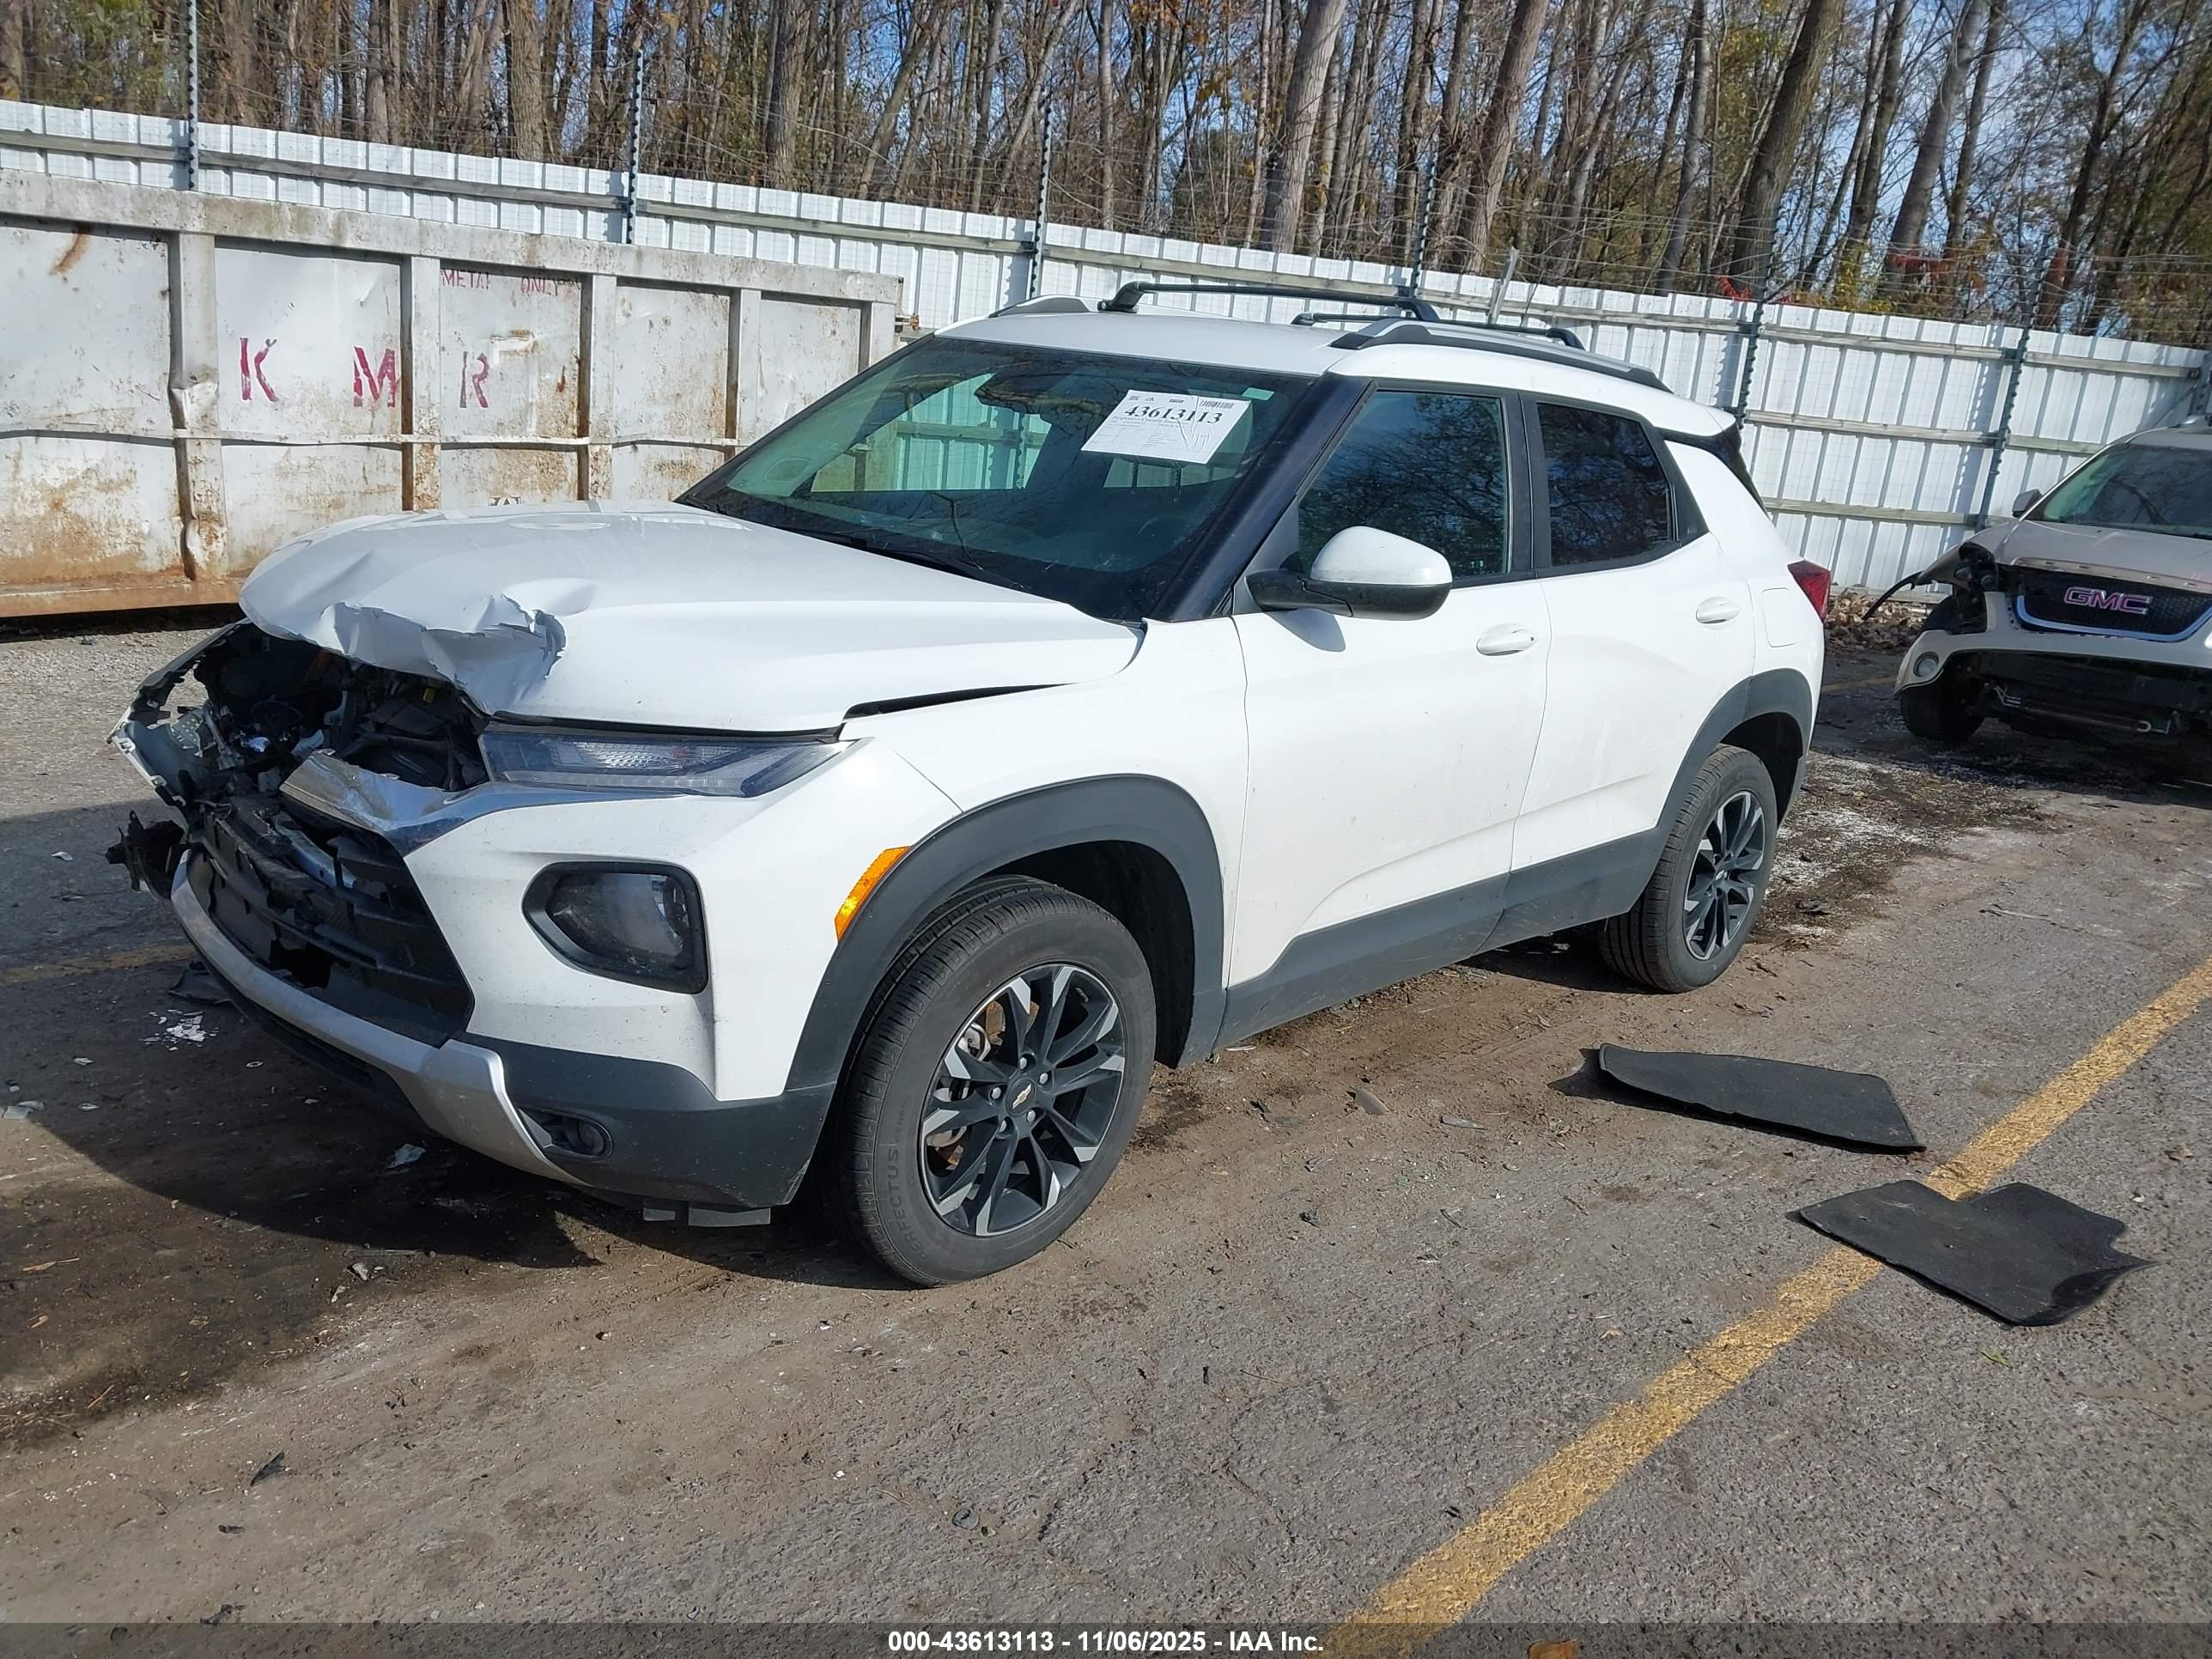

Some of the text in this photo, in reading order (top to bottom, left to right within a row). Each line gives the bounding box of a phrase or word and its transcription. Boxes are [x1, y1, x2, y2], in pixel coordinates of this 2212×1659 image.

[240, 337, 489, 409] K M R
[1124, 405, 1223, 424] 43613113
[2064, 587, 2153, 615] GMC
